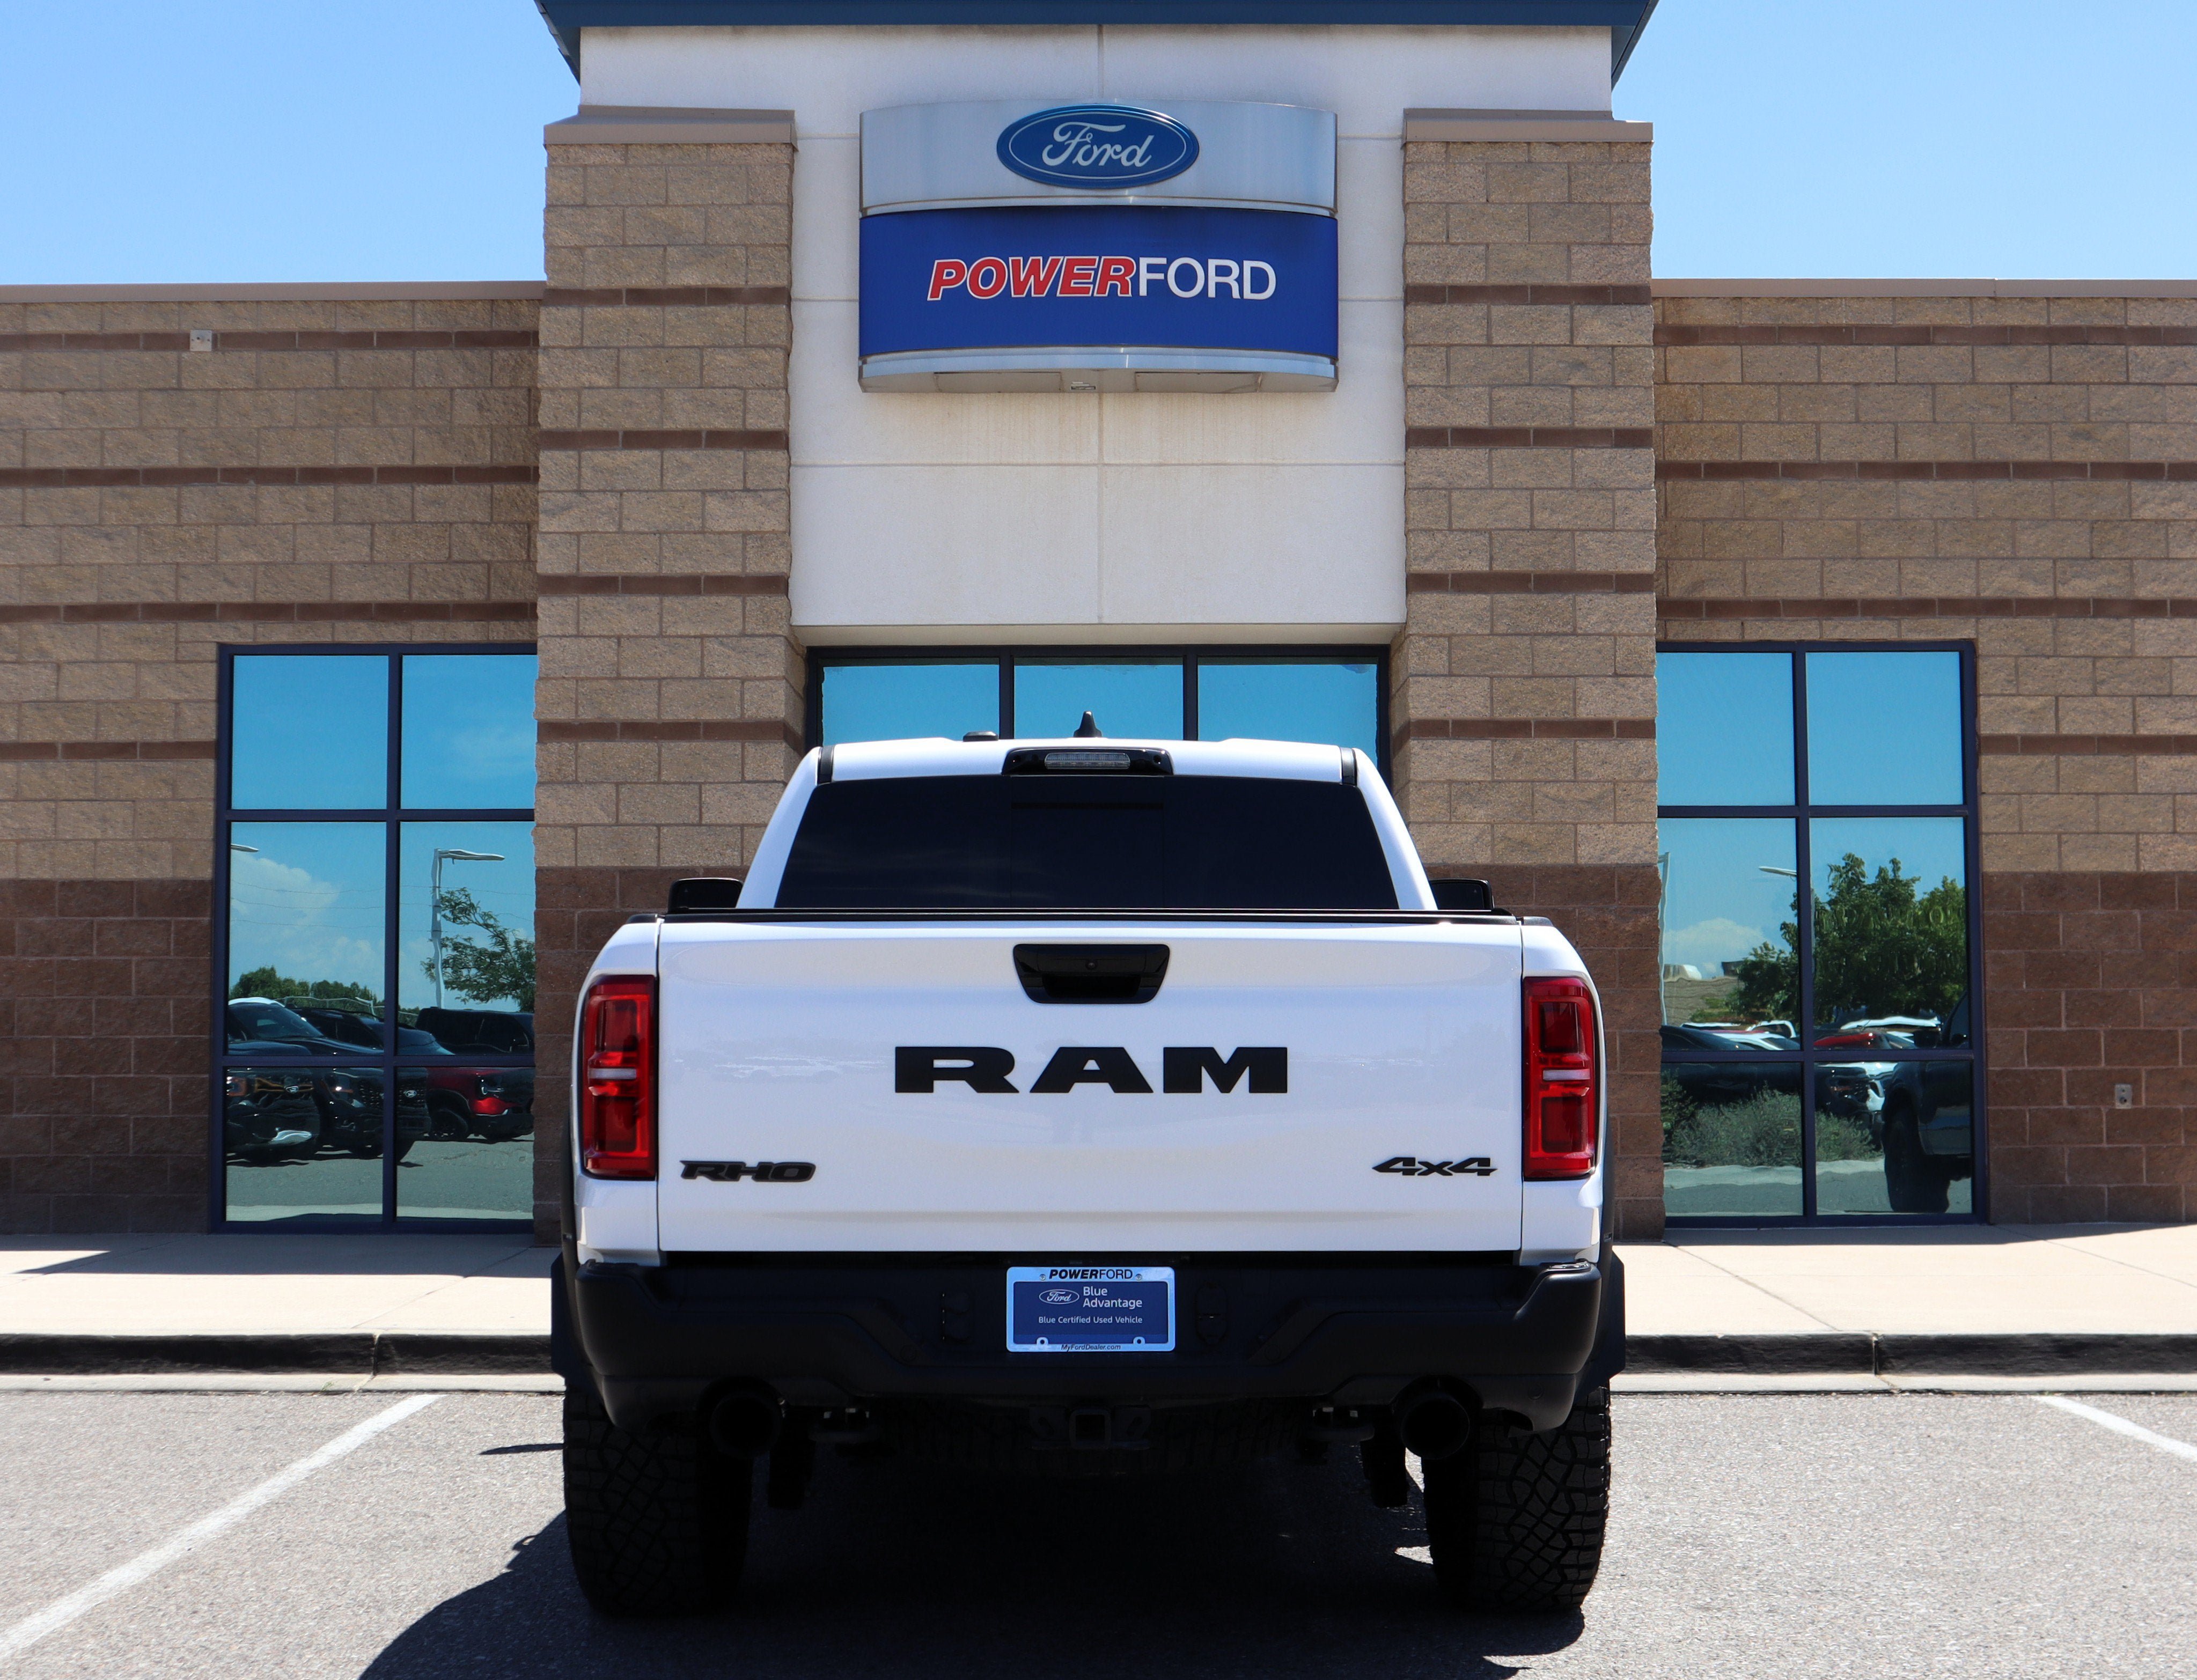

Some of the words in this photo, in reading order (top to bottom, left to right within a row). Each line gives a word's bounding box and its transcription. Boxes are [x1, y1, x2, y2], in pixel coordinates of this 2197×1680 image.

[1042, 121, 1153, 167] Ford
[895, 1047, 1287, 1093] RAM
[680, 1160, 816, 1182] RHO
[1372, 1157, 1497, 1176] 4x4
[1047, 1291, 1071, 1302] Ford
[1083, 1286, 1107, 1296] Blue
[1083, 1298, 1142, 1309] Advantage
